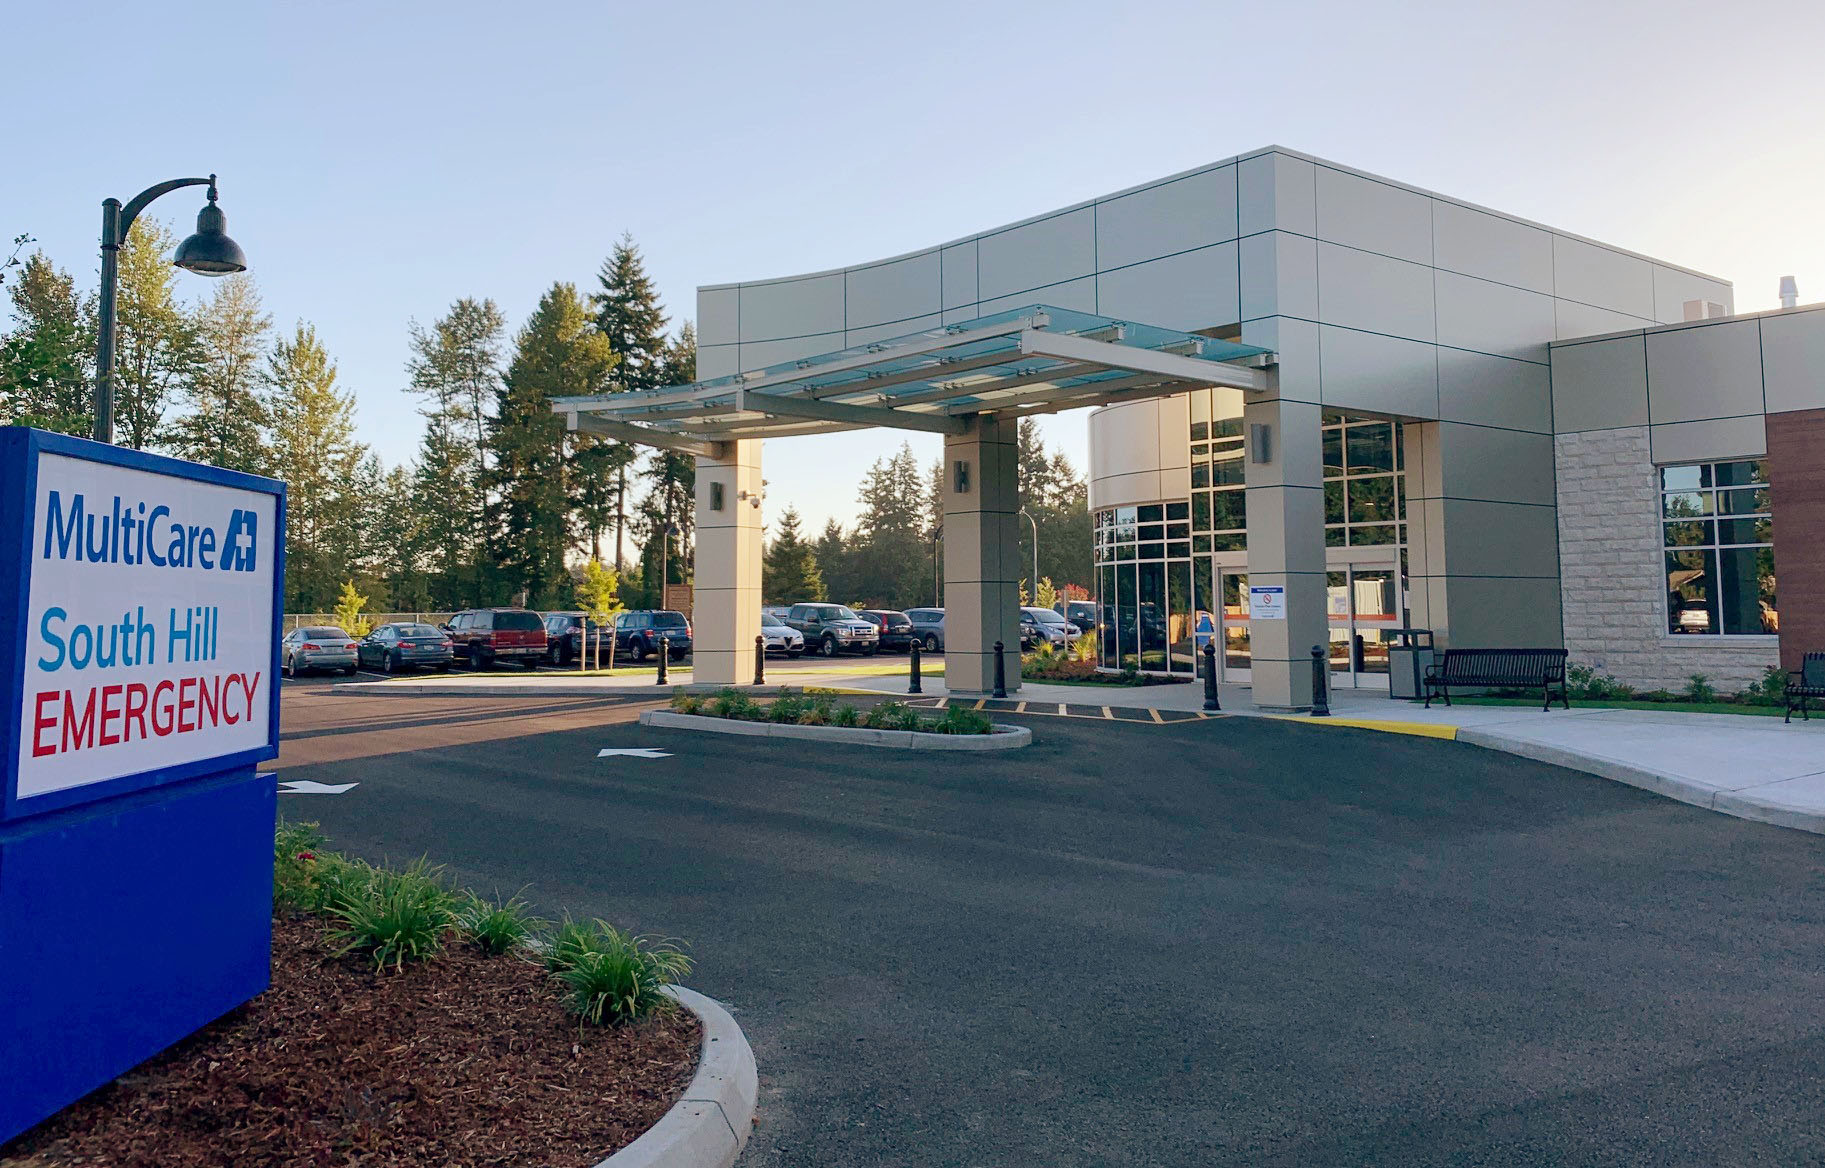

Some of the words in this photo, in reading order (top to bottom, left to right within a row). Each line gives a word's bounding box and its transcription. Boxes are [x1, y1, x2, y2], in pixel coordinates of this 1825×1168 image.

[44, 490, 216, 569] MultiCare
[38, 606, 155, 672] South
[168, 606, 218, 663] Hill
[32, 671, 261, 758] EMERGENCY
